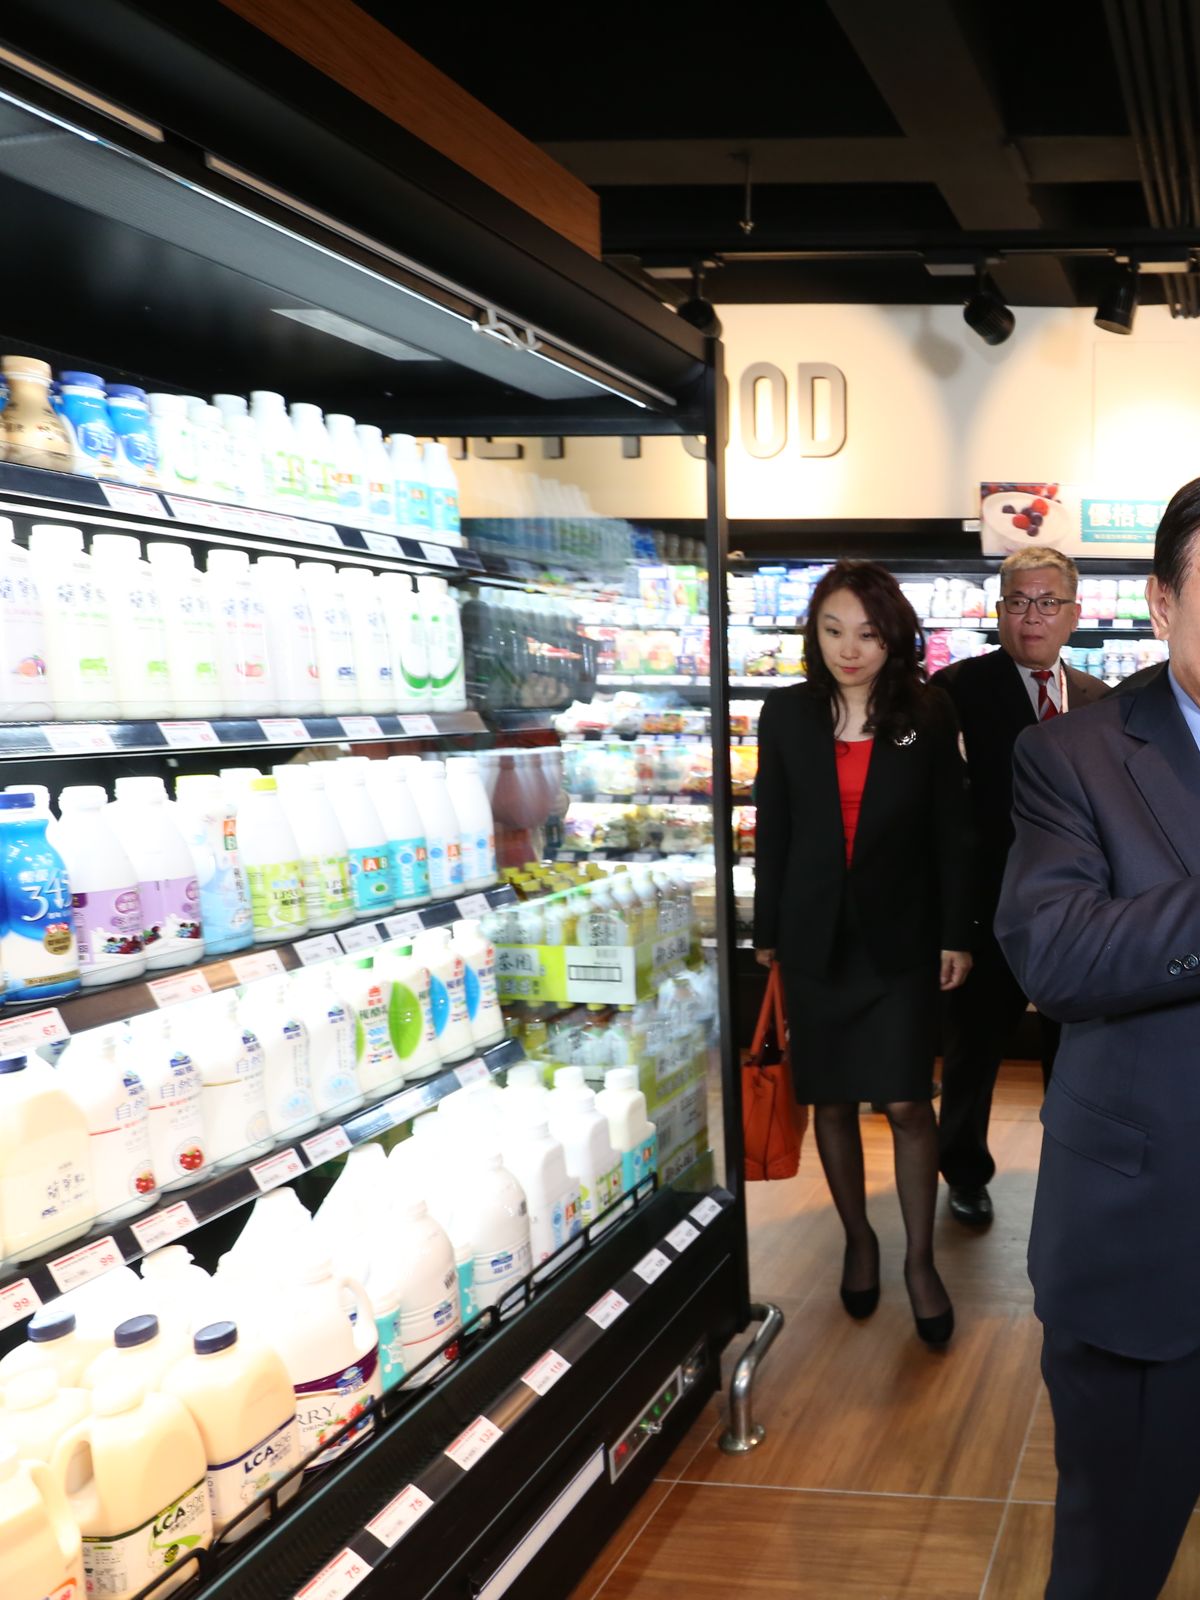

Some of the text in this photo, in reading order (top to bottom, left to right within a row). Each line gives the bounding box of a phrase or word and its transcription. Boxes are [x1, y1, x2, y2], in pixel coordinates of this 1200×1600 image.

[100, 1254, 115, 1267] 99
[13, 1297, 30, 1312] 99
[409, 1498, 424, 1512] 75
[344, 1564, 361, 1579] 75
